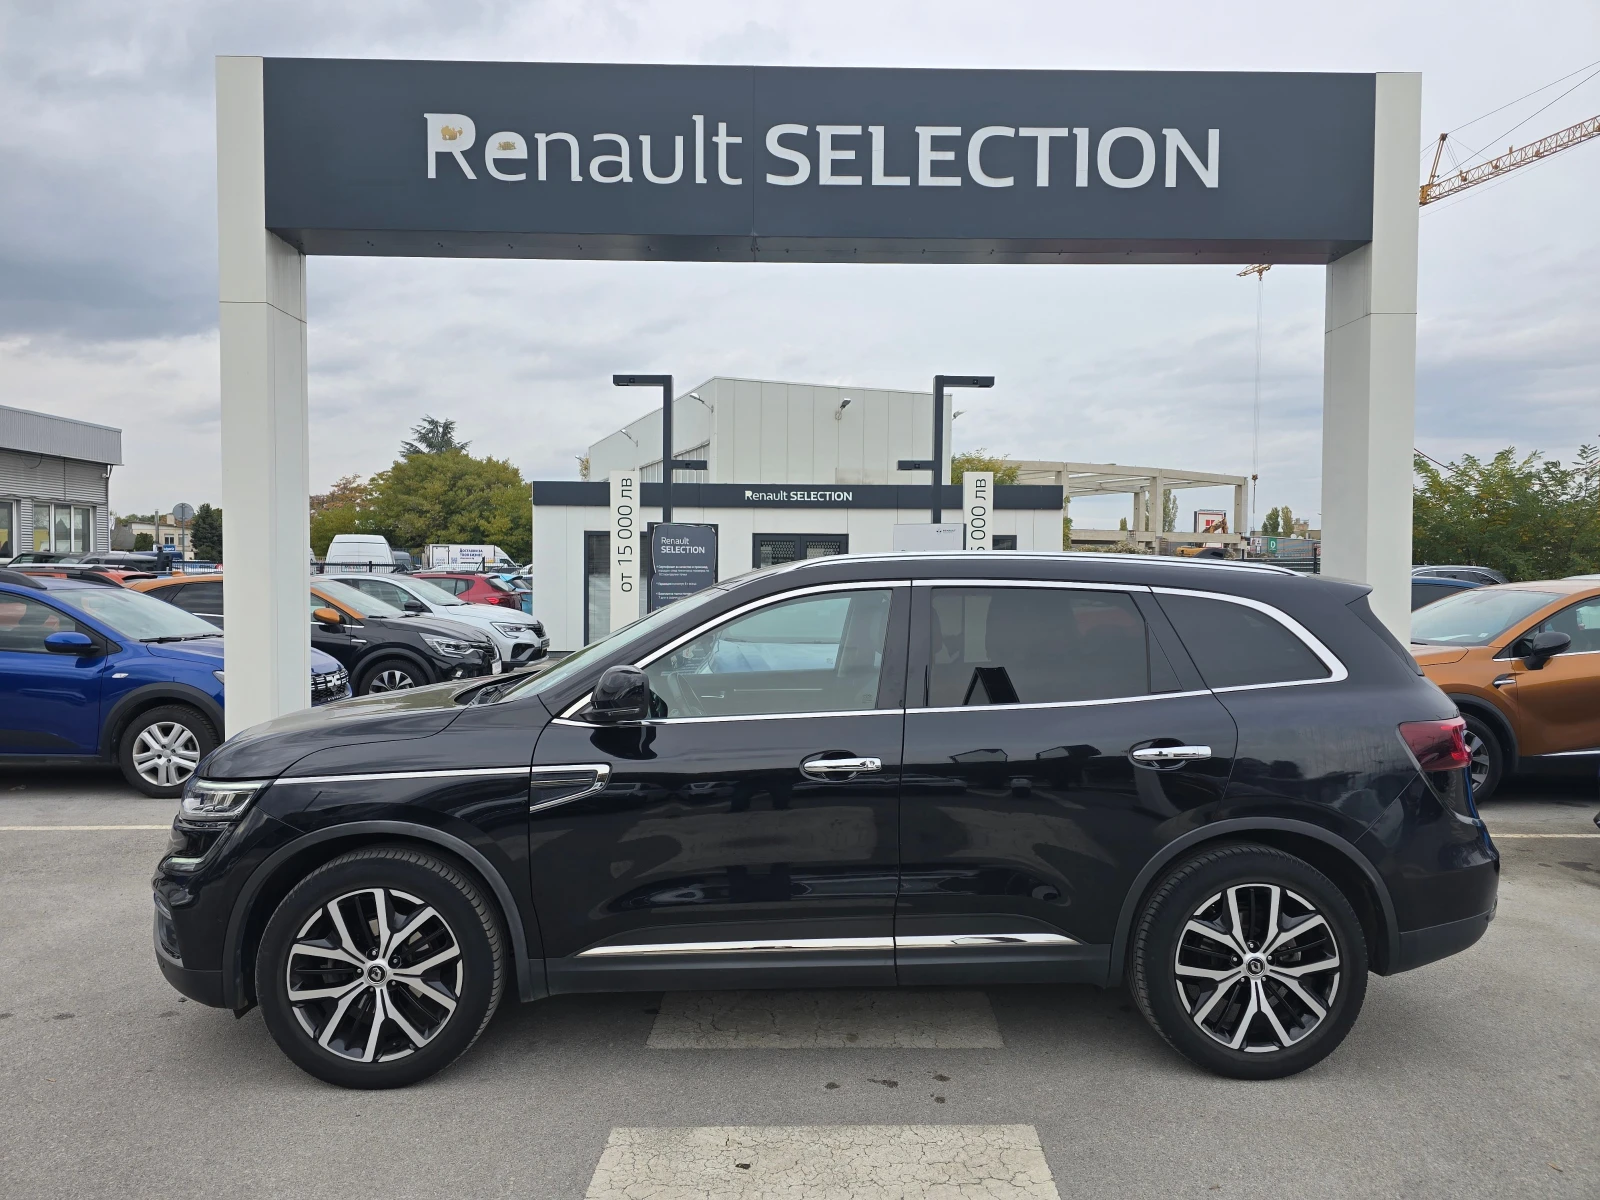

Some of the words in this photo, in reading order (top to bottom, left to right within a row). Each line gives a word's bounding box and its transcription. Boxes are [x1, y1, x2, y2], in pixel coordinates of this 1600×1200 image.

[424, 113, 743, 186] Renault
[765, 123, 1220, 188] SELECTION
[621, 478, 633, 500] лв
[744, 490, 788, 501] Renault
[789, 491, 853, 501] SELECTION
[975, 479, 987, 500] лв
[617, 505, 633, 539] 000
[970, 506, 986, 540] 000
[661, 537, 690, 545] Renault
[661, 546, 705, 554] SELECTION
[617, 545, 633, 566] 15
